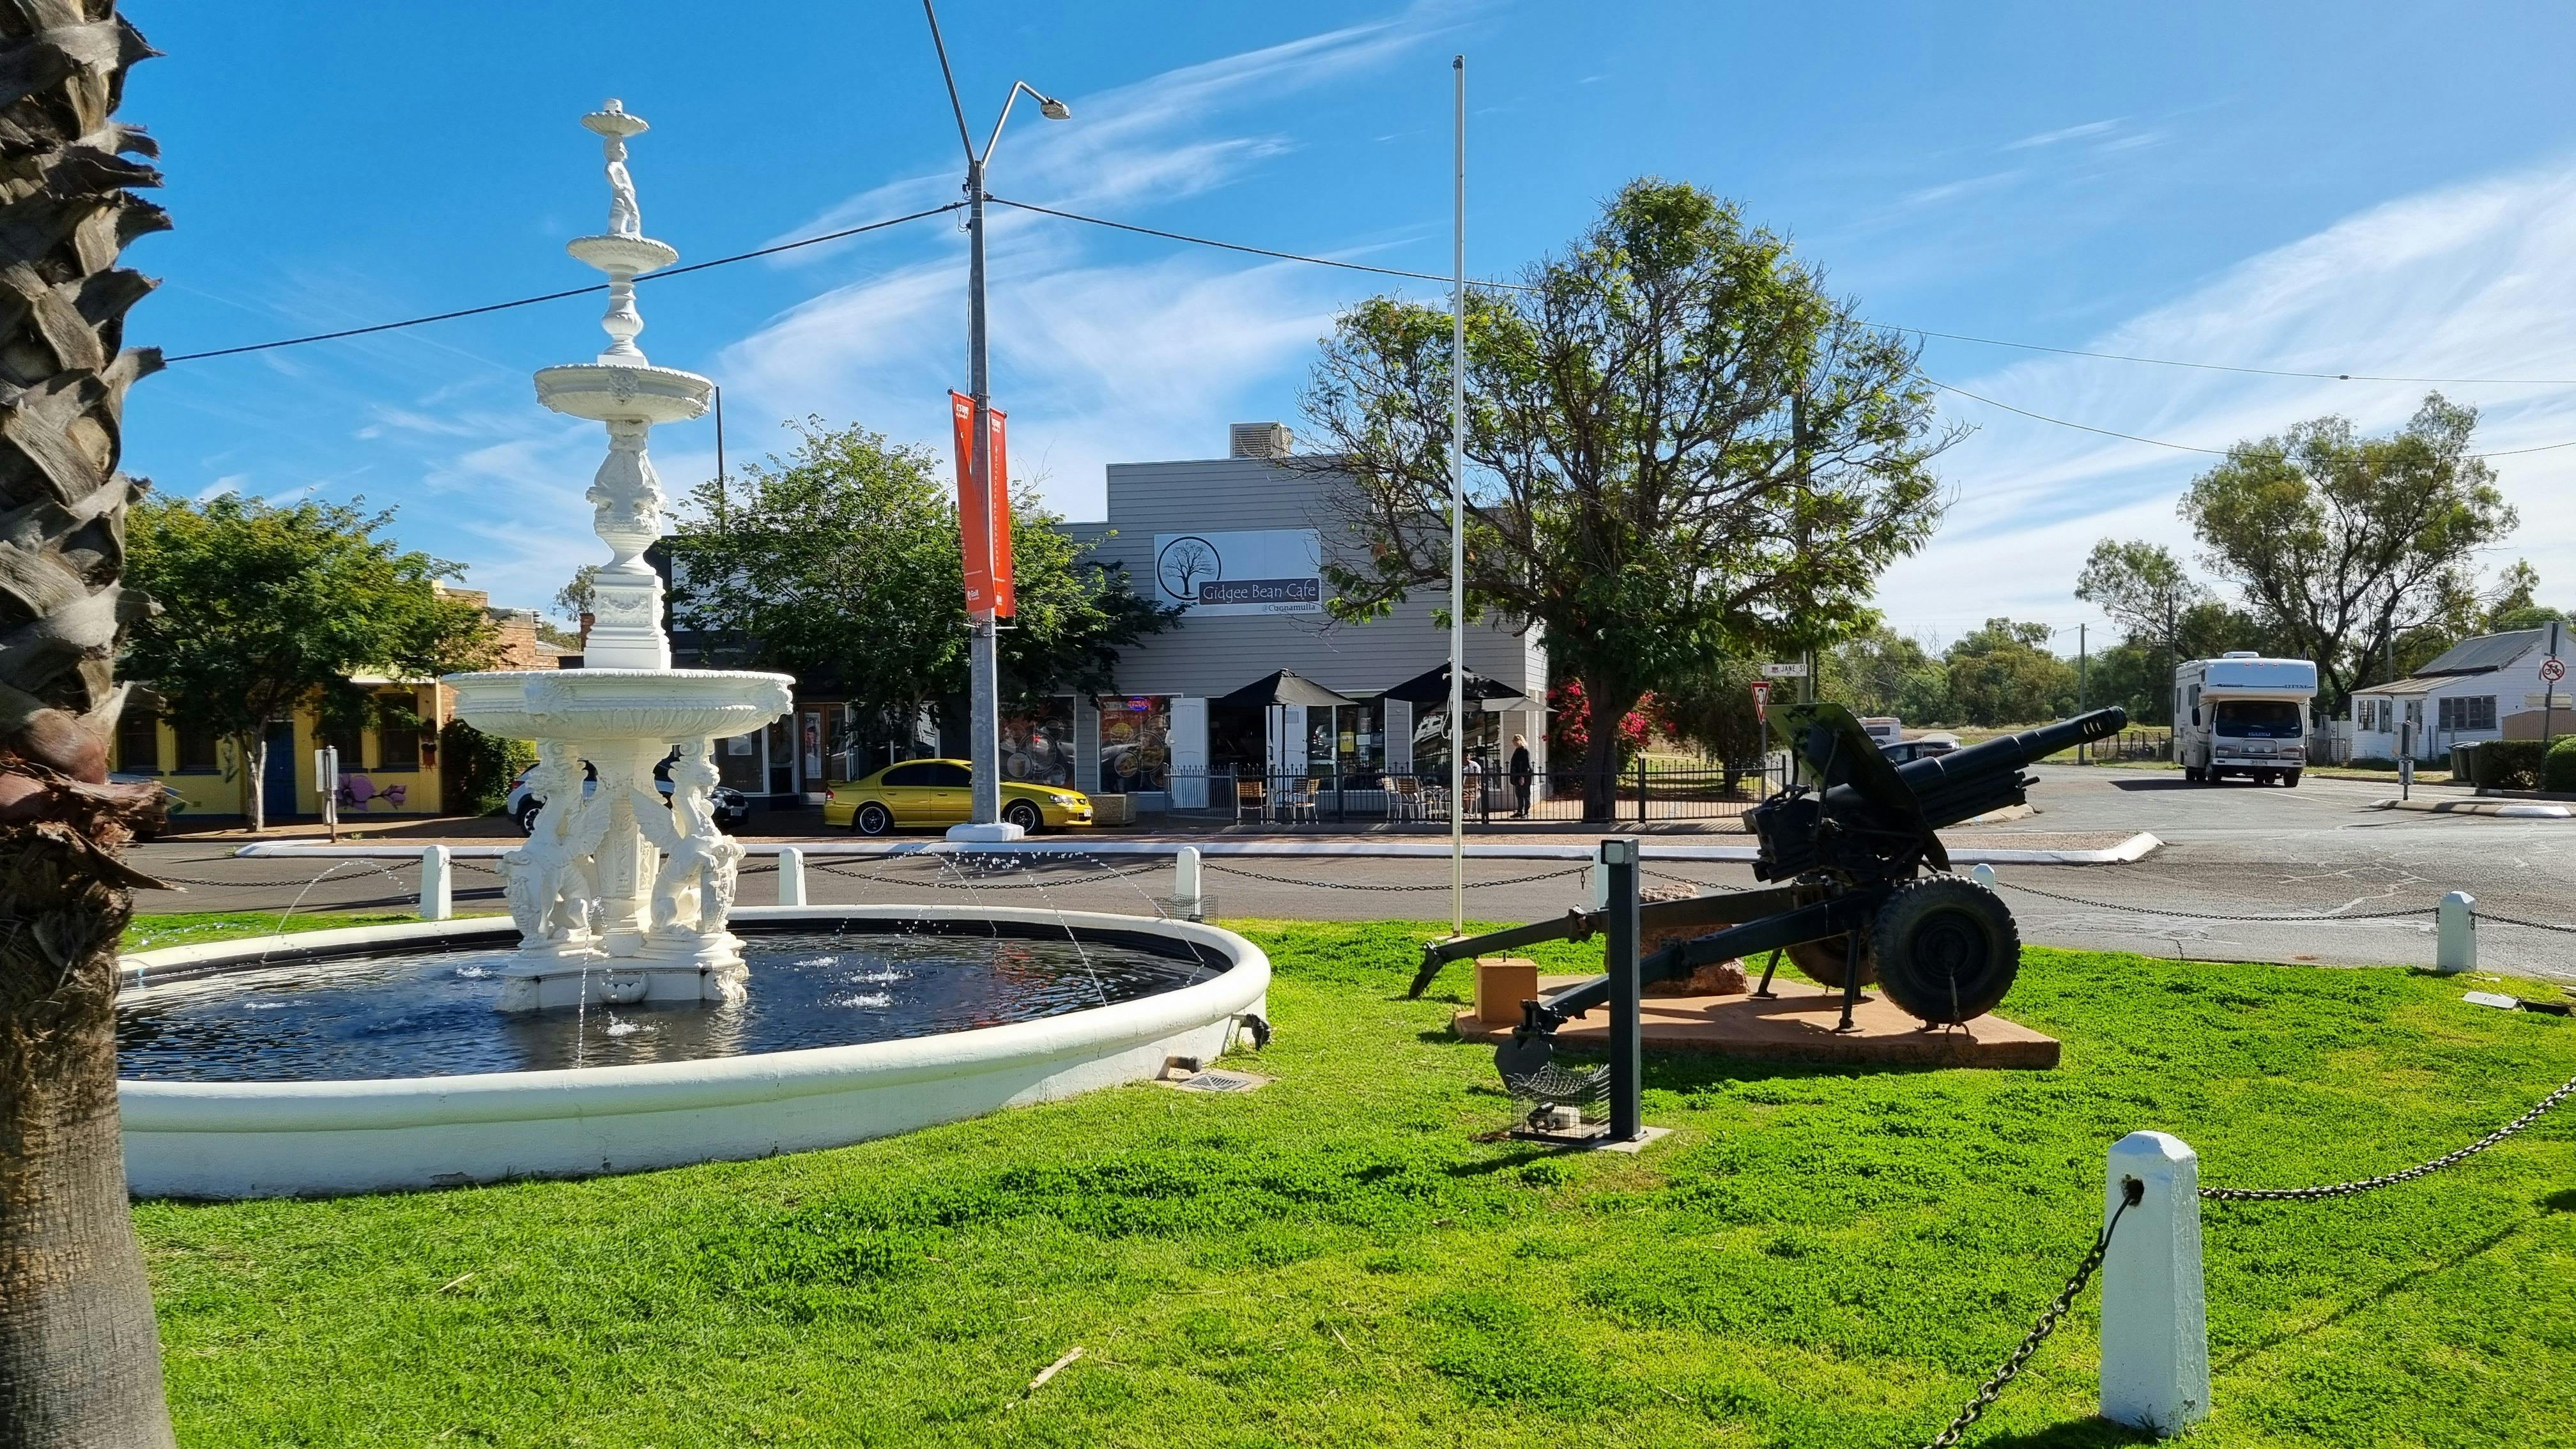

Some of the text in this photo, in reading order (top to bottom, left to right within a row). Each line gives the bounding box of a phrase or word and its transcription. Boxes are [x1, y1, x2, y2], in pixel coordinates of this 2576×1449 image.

[1203, 579, 1315, 603] Gidgee Bean Cafe
